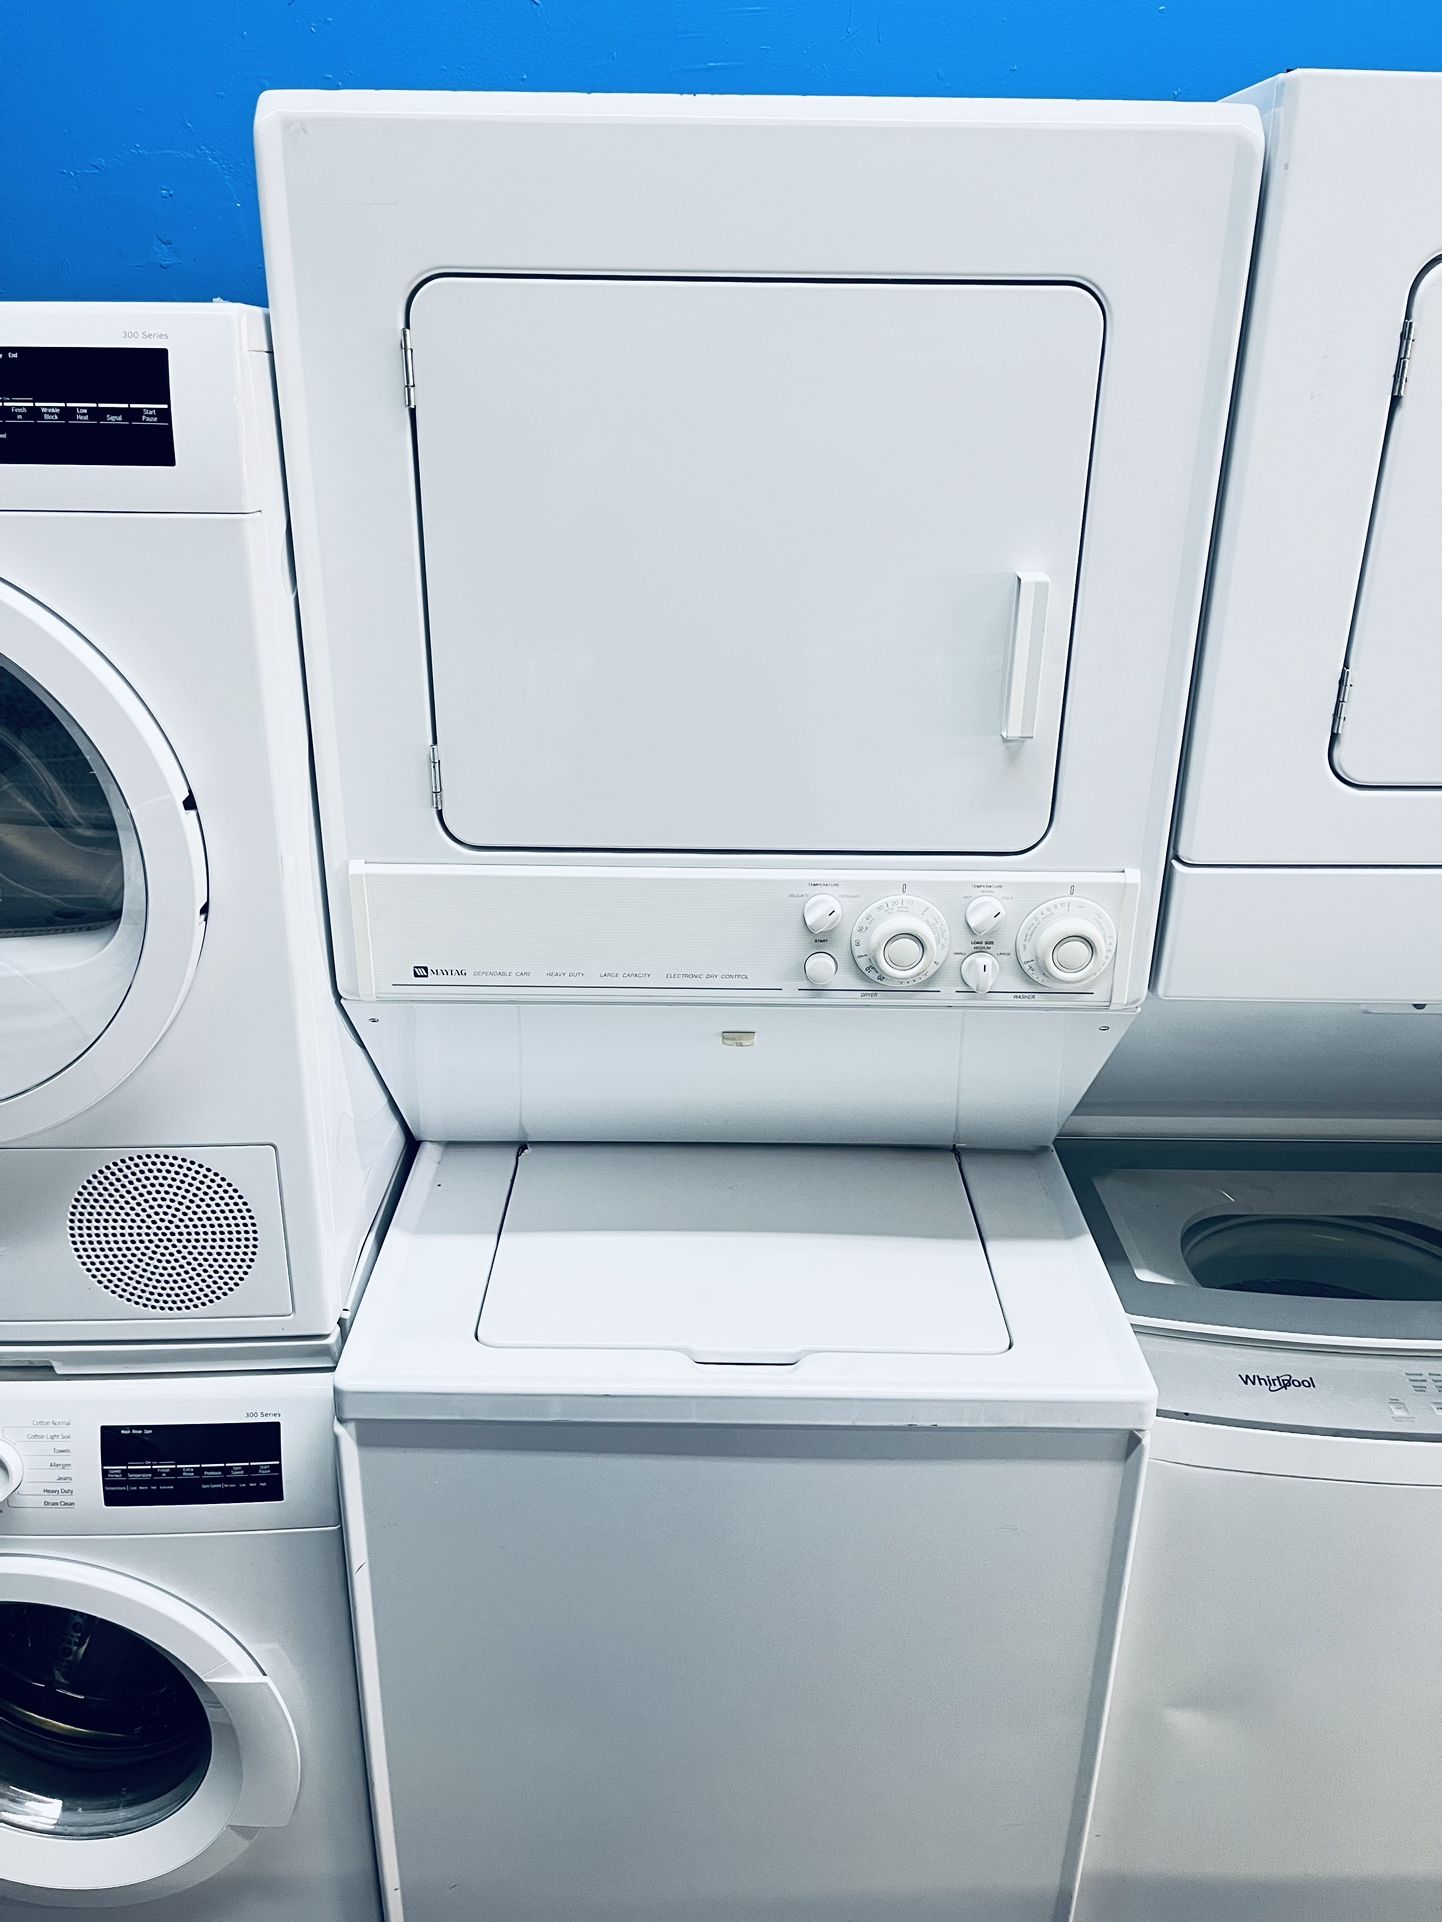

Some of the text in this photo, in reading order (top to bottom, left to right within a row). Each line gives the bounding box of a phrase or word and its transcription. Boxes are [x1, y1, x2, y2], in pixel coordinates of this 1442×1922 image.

[121, 331, 169, 340] 300 Series
[429, 968, 467, 977] MAYTAG
[1238, 1374, 1316, 1392] Whirlpool
